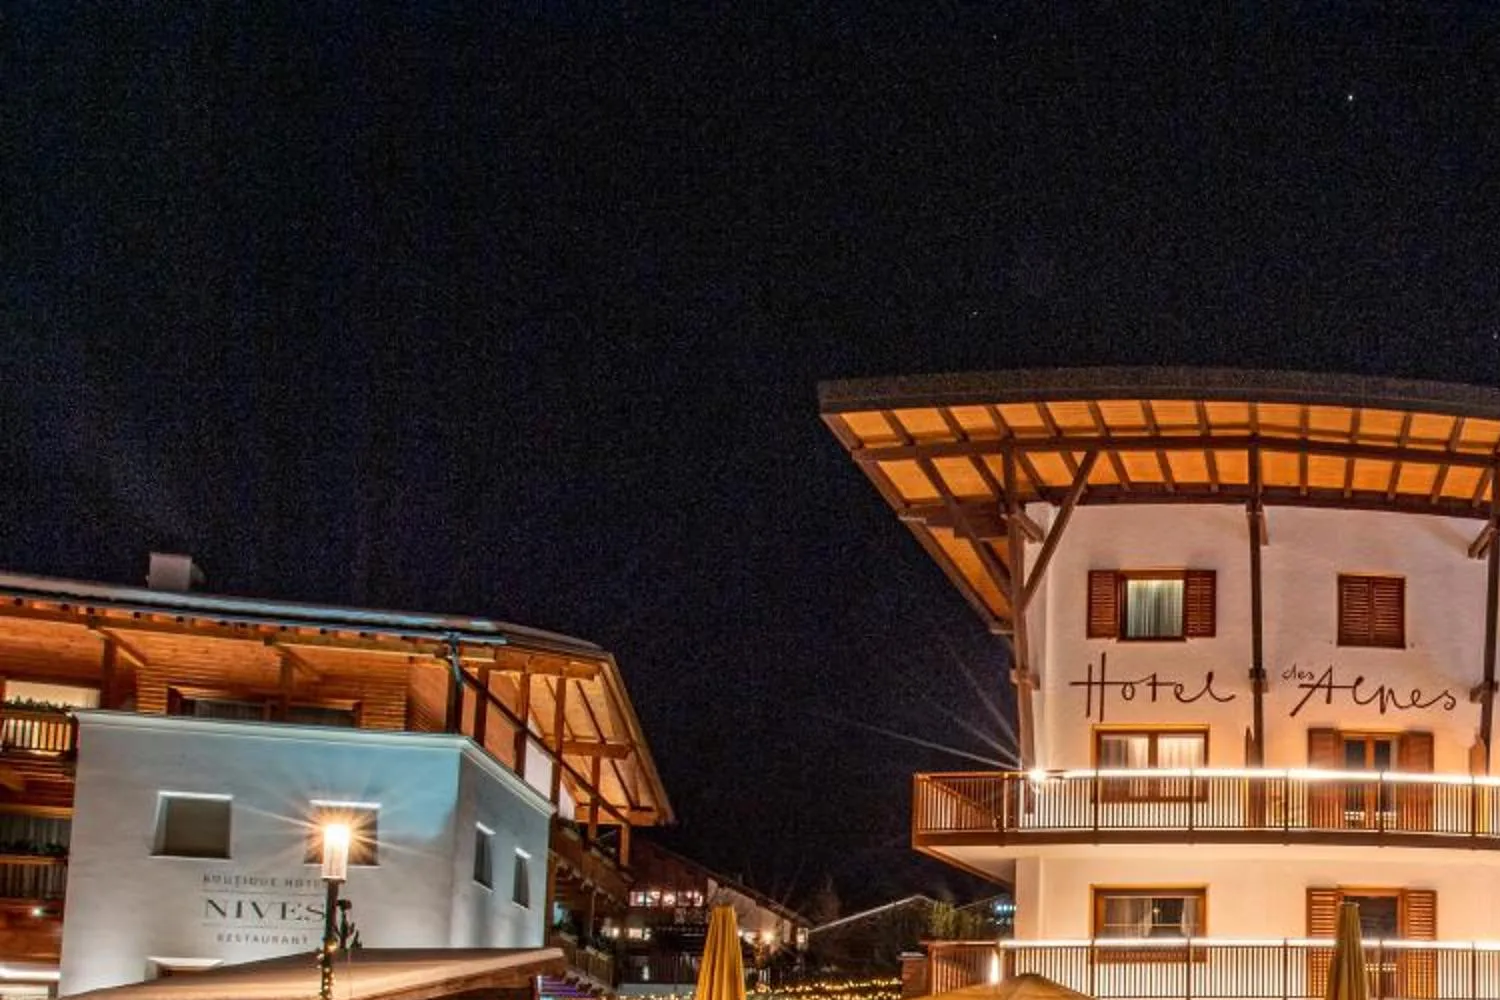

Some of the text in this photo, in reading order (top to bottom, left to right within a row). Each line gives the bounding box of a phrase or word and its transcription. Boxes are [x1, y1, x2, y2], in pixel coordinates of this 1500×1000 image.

[1069, 652, 1236, 722] Hotel
[1281, 665, 1457, 716] des Alpes
[284, 877, 328, 889] HOTE
[206, 899, 325, 921] NIVES
[217, 932, 308, 945] RESTAURANT
